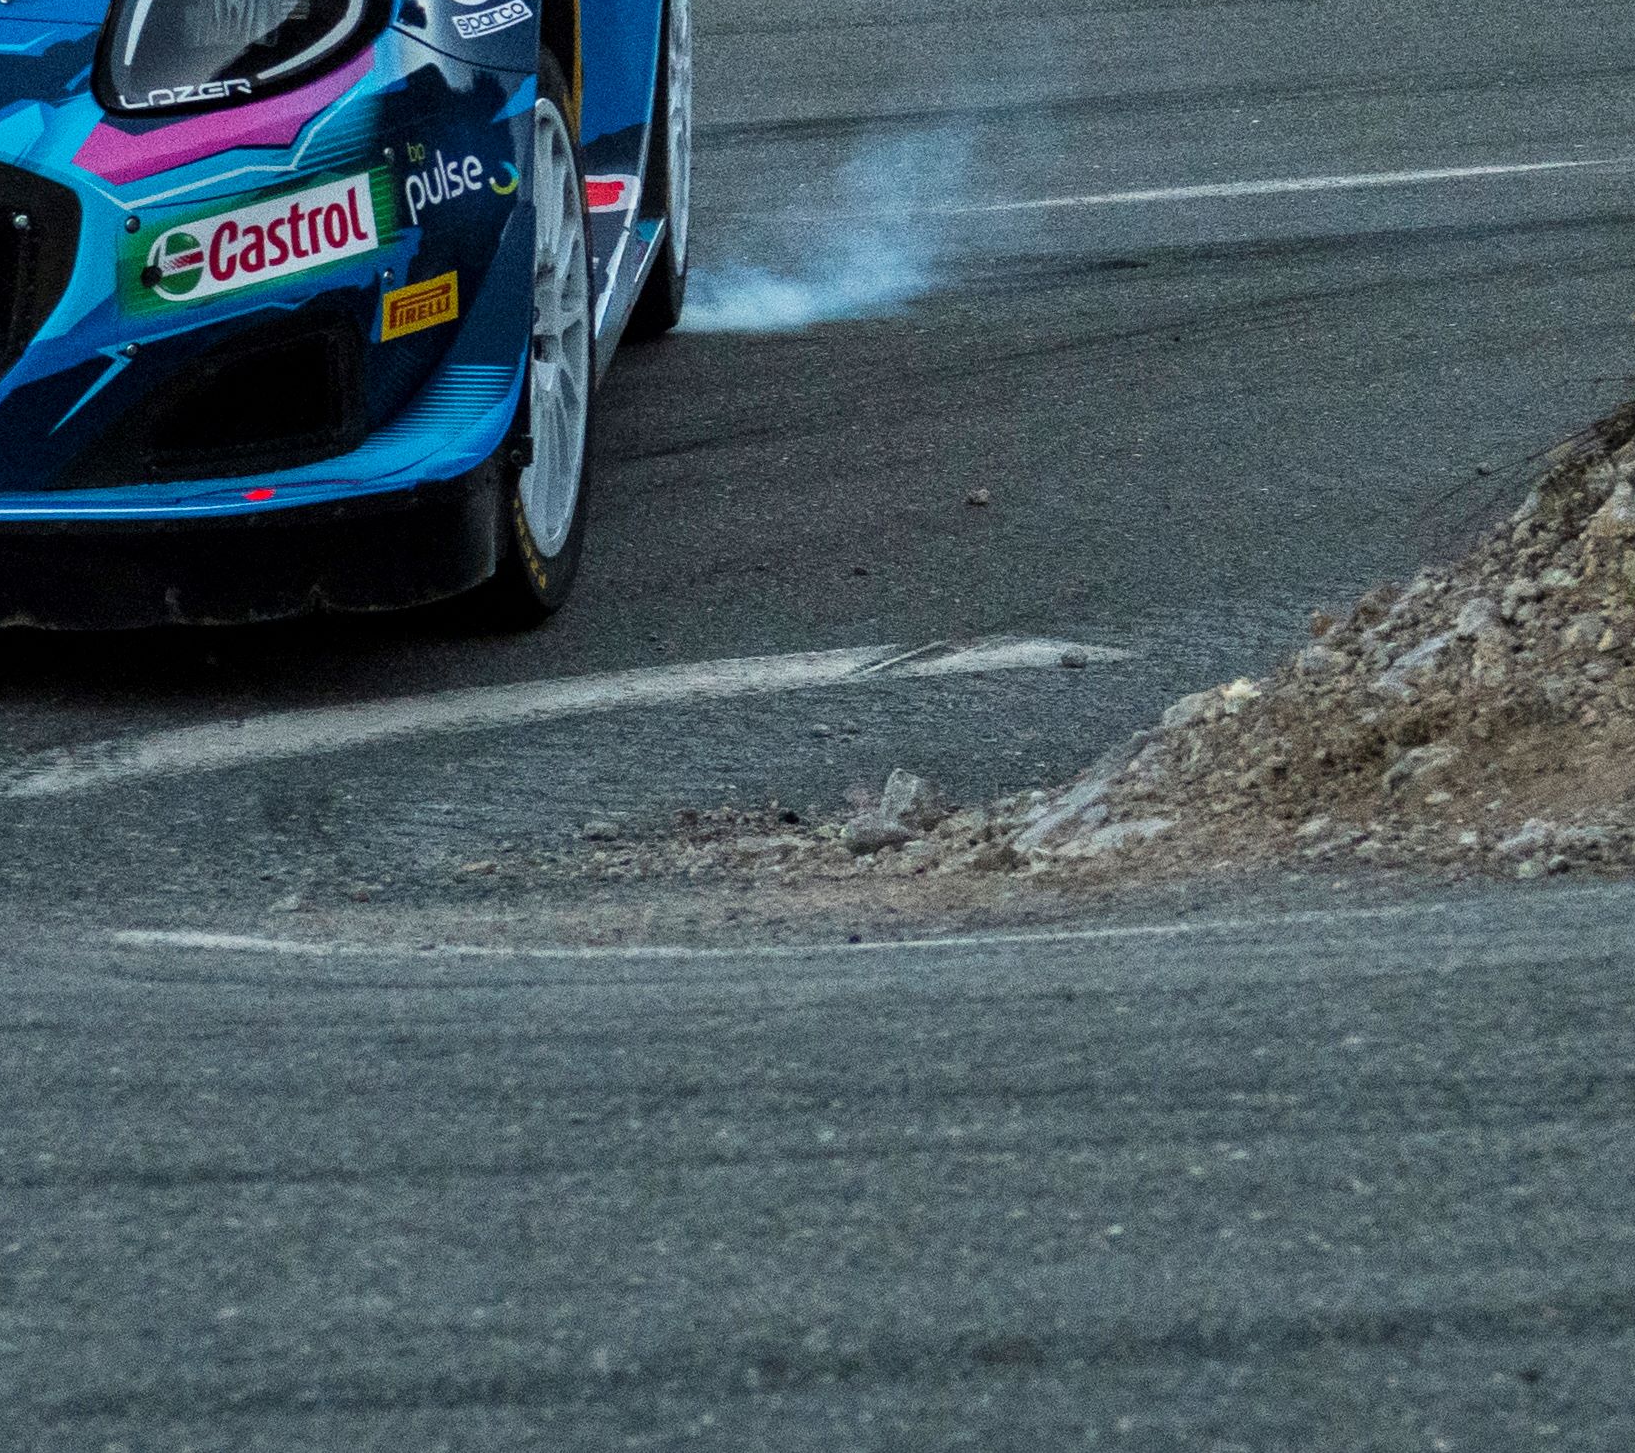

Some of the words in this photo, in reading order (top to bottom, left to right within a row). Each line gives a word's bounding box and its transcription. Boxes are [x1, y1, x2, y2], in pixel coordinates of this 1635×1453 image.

[457, 2, 524, 35] sparco
[405, 149, 483, 226] pulse
[209, 187, 368, 282] Castrol
[388, 282, 452, 330] PIRELLI
